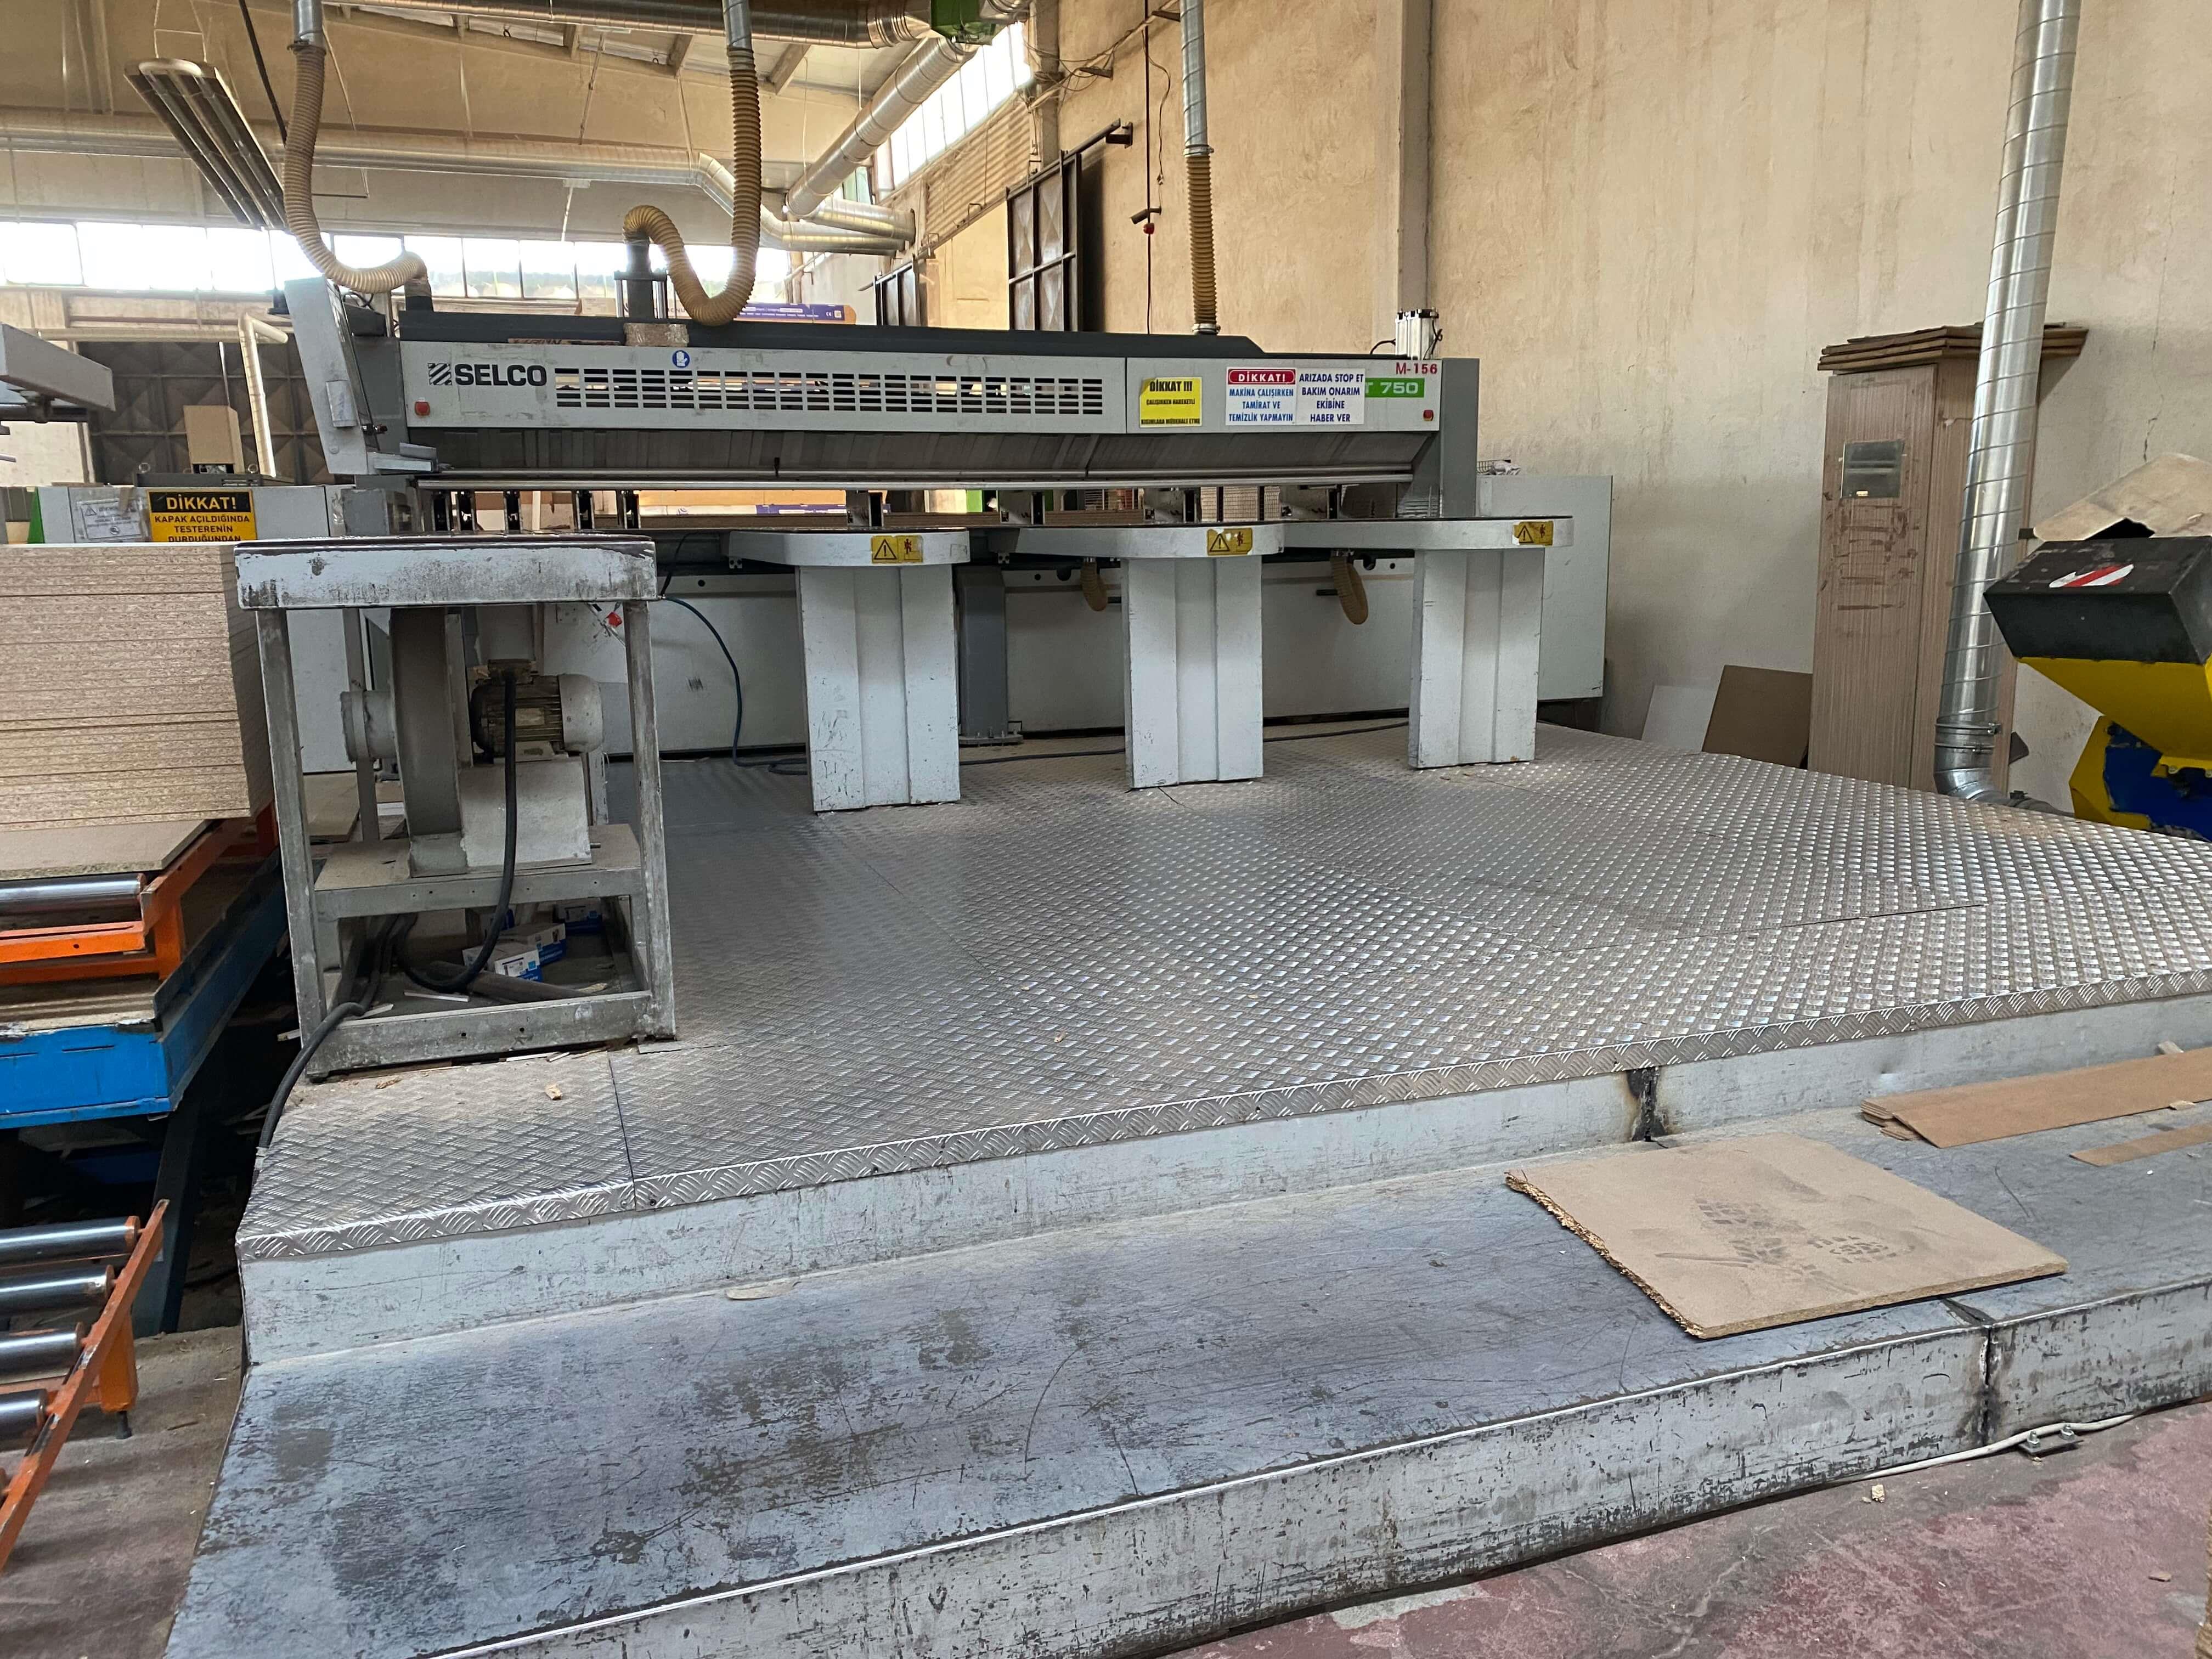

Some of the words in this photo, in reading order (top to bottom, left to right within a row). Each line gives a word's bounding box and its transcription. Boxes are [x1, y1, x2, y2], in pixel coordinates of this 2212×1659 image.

[1396, 362, 1437, 375] M-156
[454, 363, 548, 386] SELCO
[1238, 371, 1285, 382] DİKKAT!
[1299, 374, 1333, 382] ARIZADA
[1335, 374, 1353, 382] STOP
[1356, 374, 1364, 382] ET
[1229, 387, 1255, 397] MAKİNA
[1257, 388, 1294, 398] ÇALIŞIRKEN
[1302, 387, 1327, 396] BAKIM
[1329, 387, 1360, 396] ONARIM
[1380, 382, 1419, 394] 750
[1242, 400, 1270, 409] TAMİRAT
[1272, 401, 1280, 409] VE
[1316, 398, 1345, 409] EKİBİNE
[1229, 413, 1257, 422] TEMİZLİK
[1260, 414, 1294, 422] YAPMAYIN
[1310, 414, 1334, 422] HABER
[1336, 414, 1351, 422] VER
[166, 494, 236, 510] DİKKAT!
[189, 515, 250, 523] AÇILDIĞINDA
[174, 524, 233, 533] TESTERENİN
[168, 534, 241, 542] DURDUĞUNDAN
